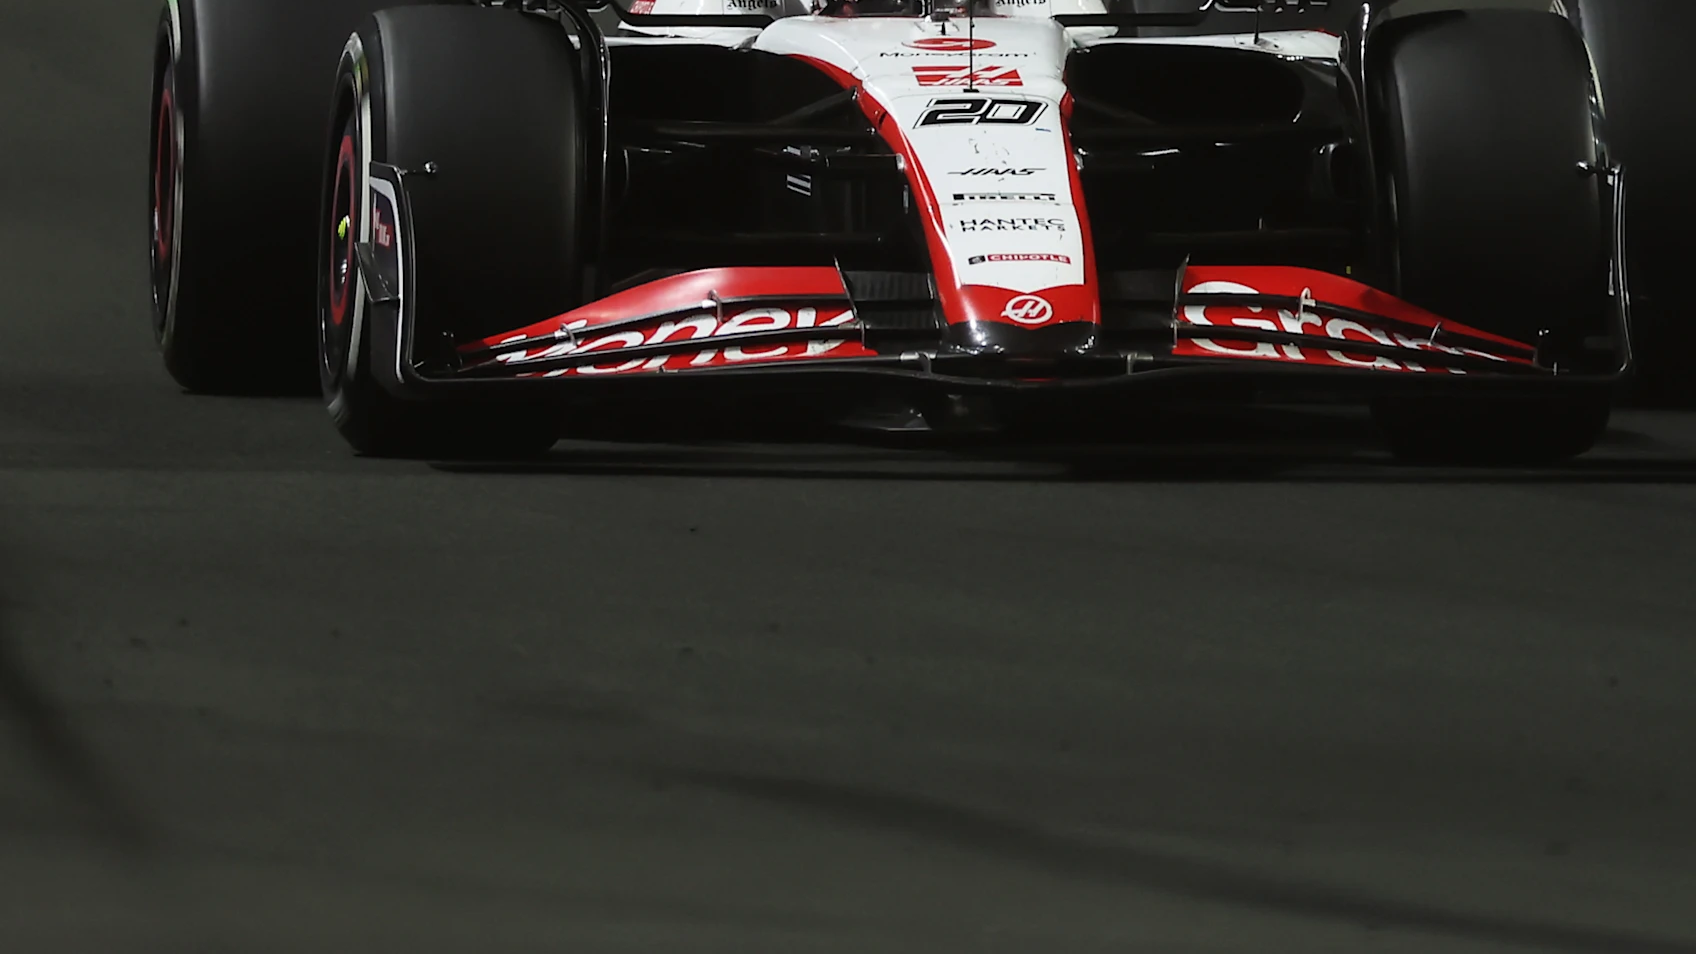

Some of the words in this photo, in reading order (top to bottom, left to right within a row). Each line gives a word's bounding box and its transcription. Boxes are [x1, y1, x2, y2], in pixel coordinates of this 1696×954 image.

[912, 97, 1048, 130] 20
[947, 167, 1047, 176] HAAS
[960, 218, 1065, 227] HANTEC
[989, 254, 1070, 264] CHIPOTLE
